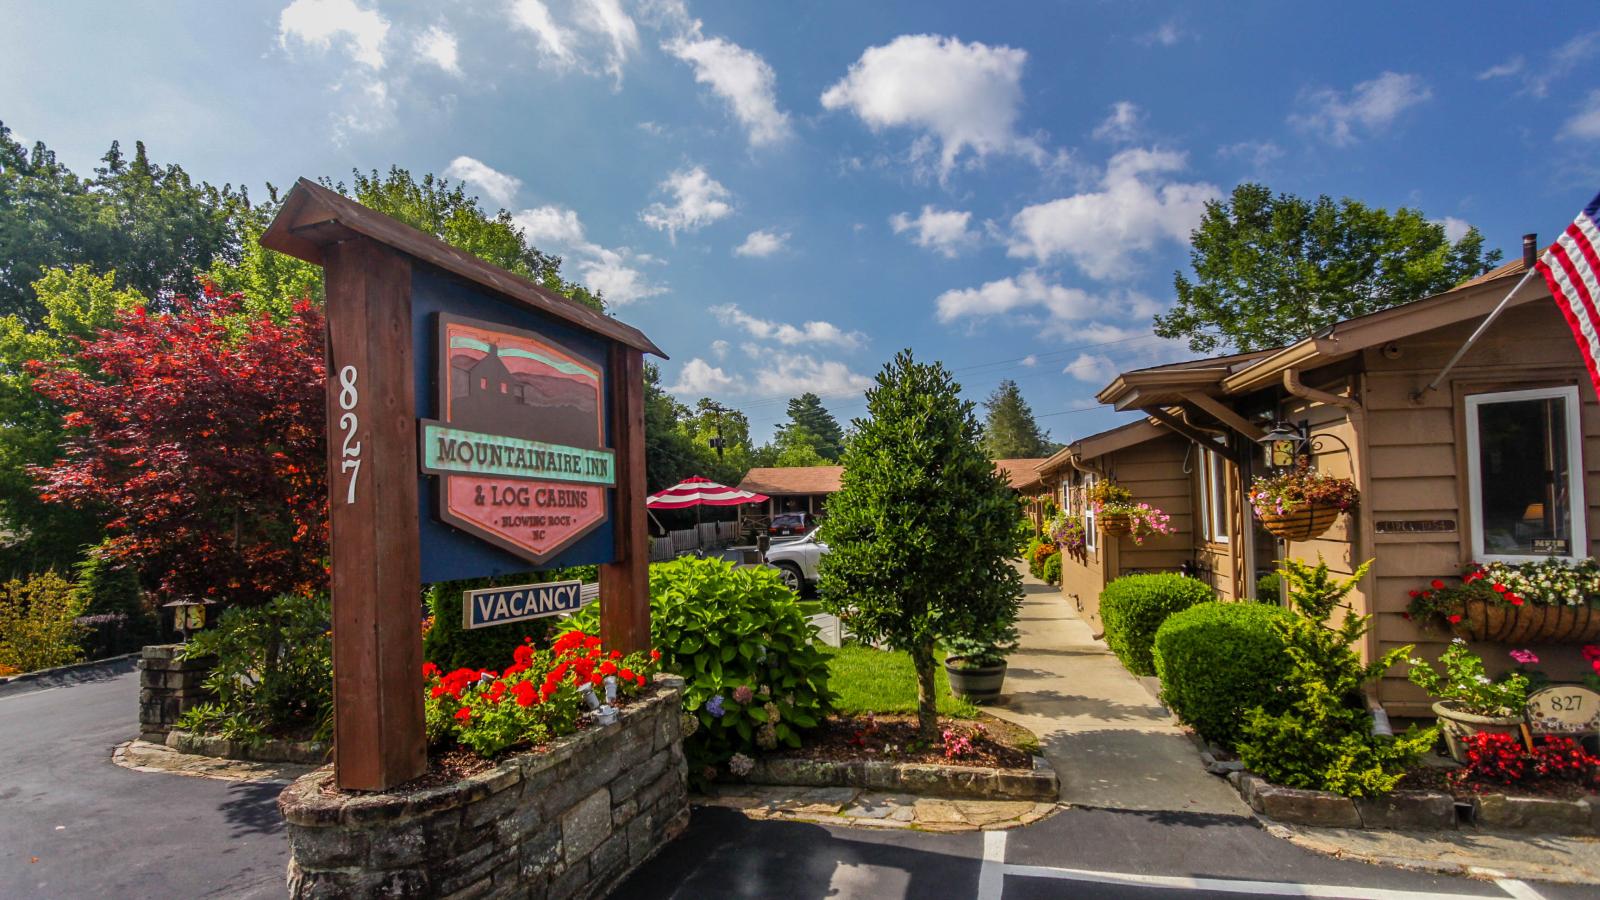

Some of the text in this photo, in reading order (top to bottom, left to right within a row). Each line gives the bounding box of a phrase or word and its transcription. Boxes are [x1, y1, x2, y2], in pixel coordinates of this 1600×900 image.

[339, 365, 361, 504] 827
[437, 437, 608, 477] MOUNTAINAIRE INN
[474, 485, 588, 508] & LOG CABINS
[501, 515, 571, 527] BLOWING ROCK
[532, 530, 546, 541] NC
[478, 586, 578, 621] VACANCY
[1551, 695, 1582, 711] 827
